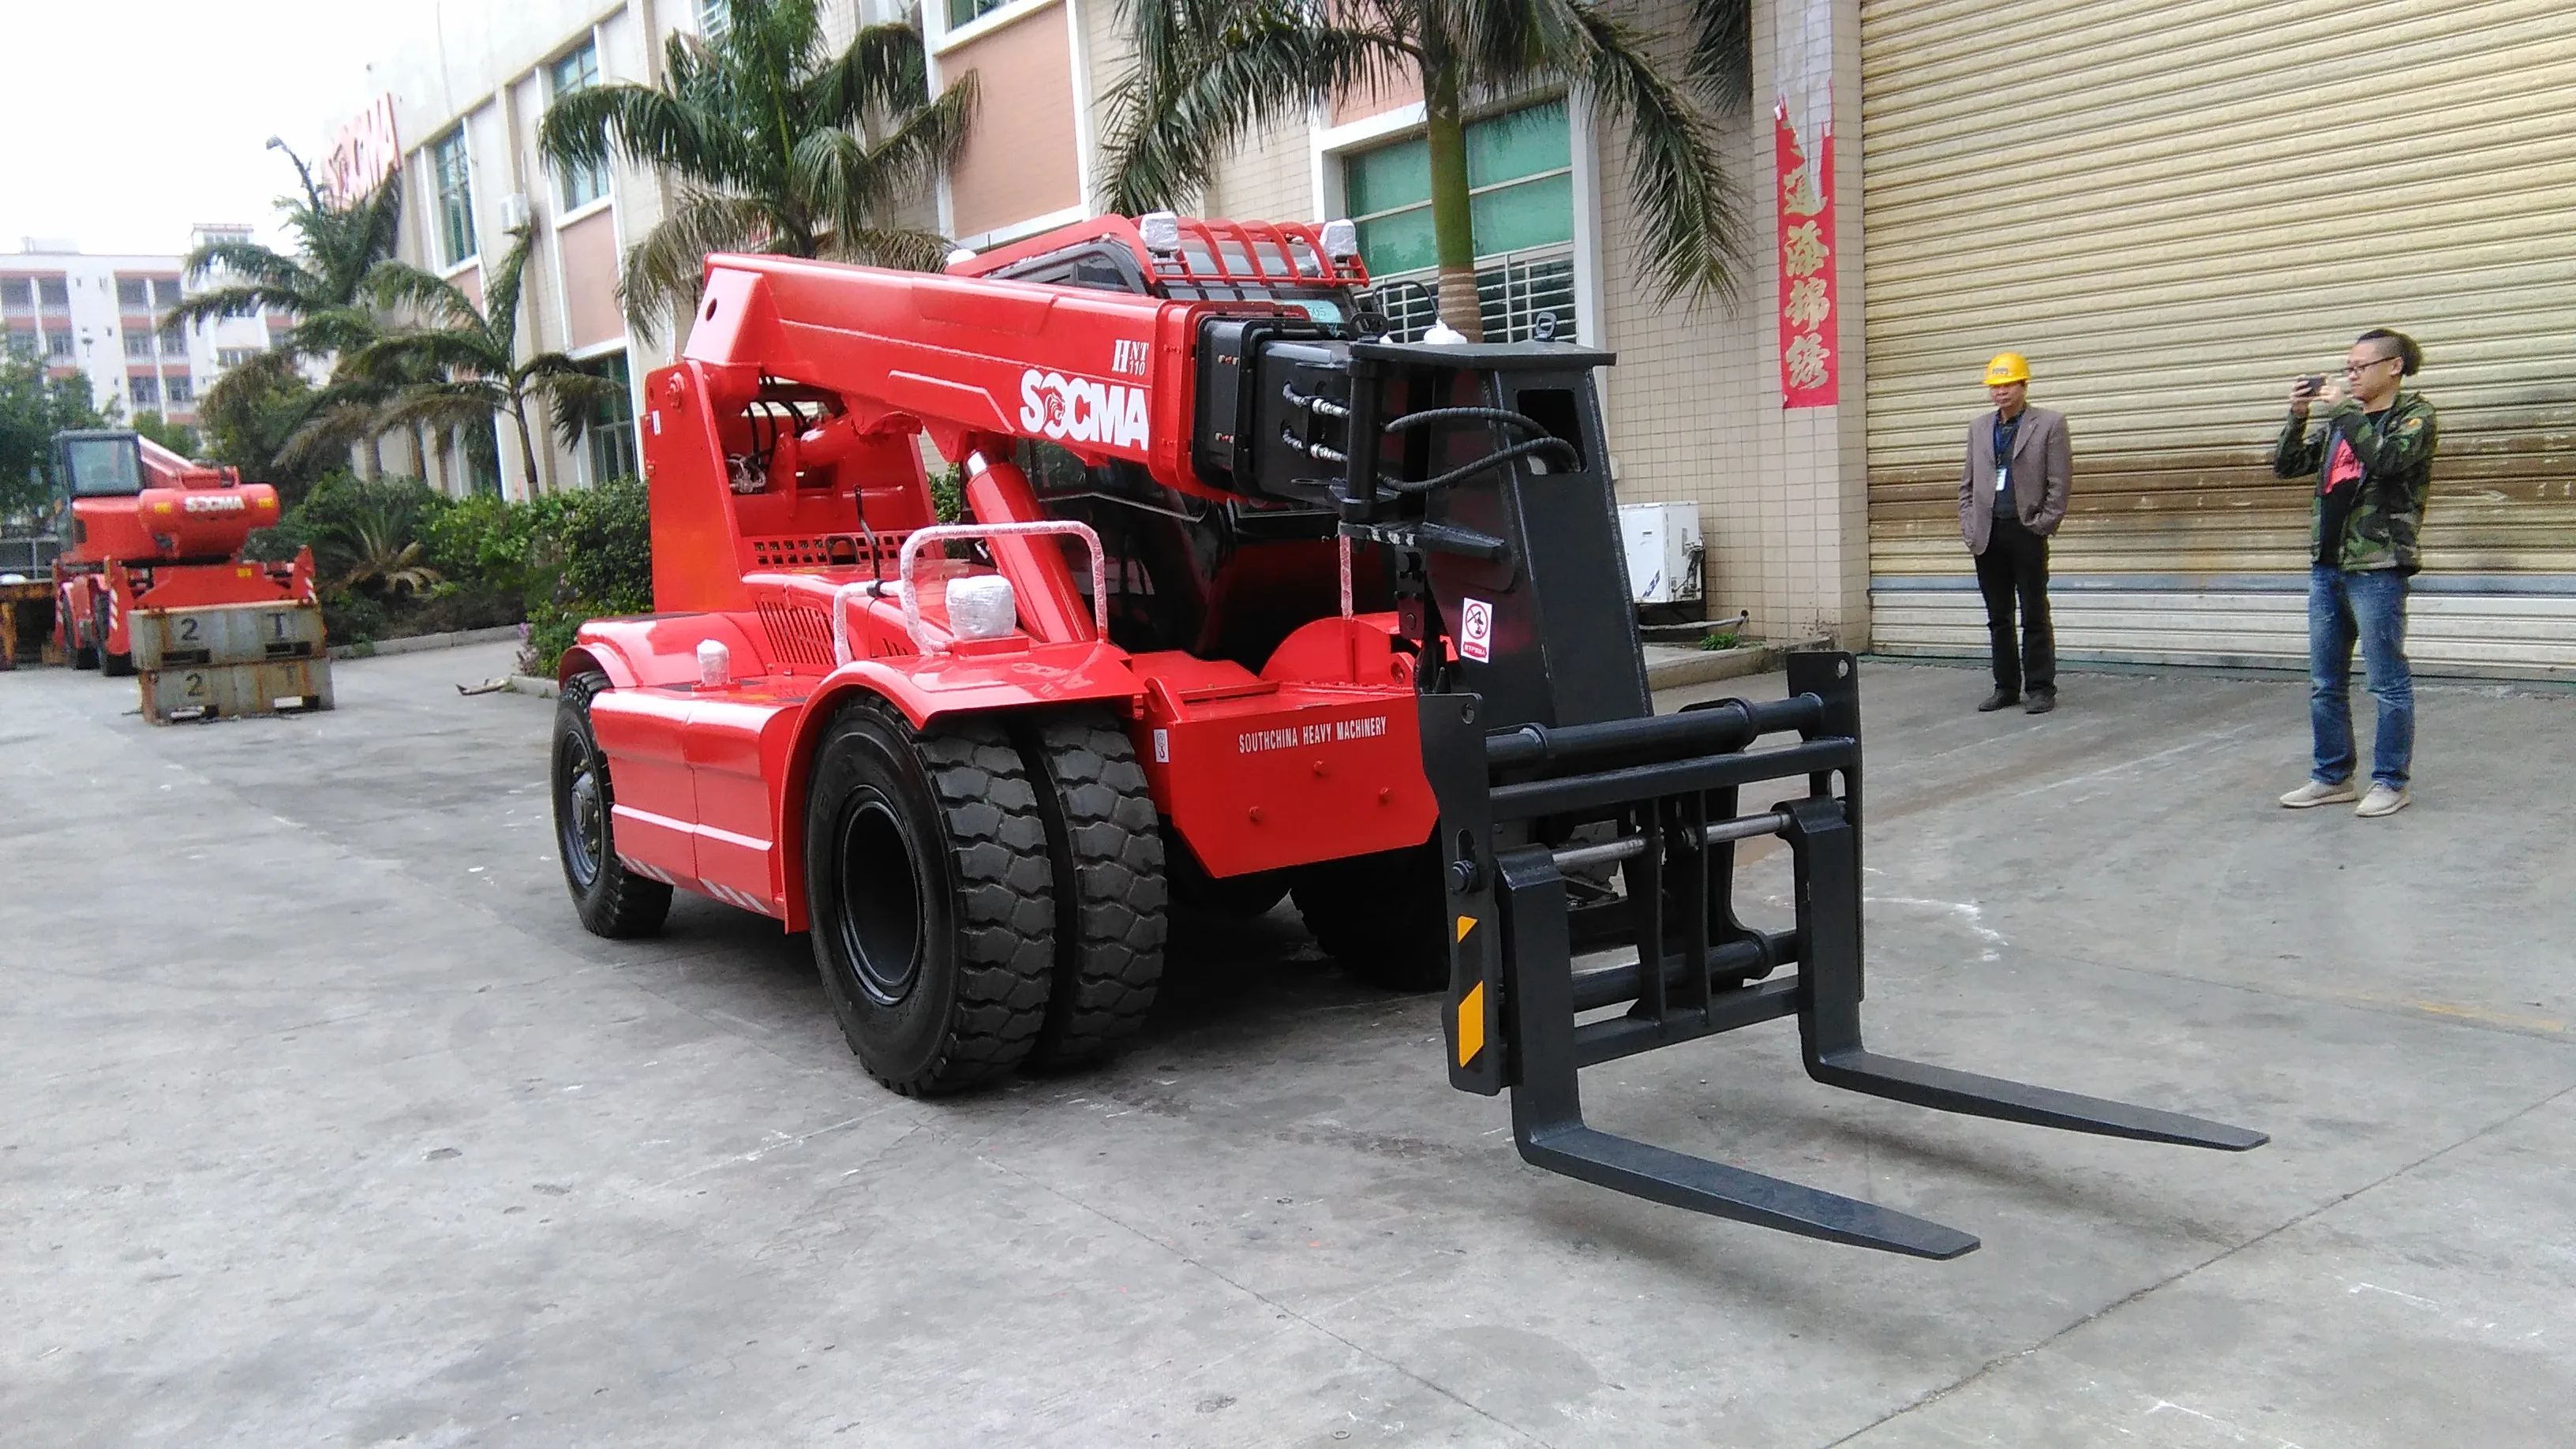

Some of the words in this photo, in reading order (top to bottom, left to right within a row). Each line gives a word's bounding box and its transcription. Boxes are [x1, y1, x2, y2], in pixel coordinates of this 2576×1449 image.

[1129, 360, 1146, 376] 110
[1019, 369, 1150, 451] SOCMA
[181, 617, 200, 641] 2
[185, 672, 204, 697] 2
[1238, 726, 1298, 754] SOUTHCHINA
[1302, 722, 1332, 746] HEAVY
[1336, 716, 1387, 742] MACHINERY
